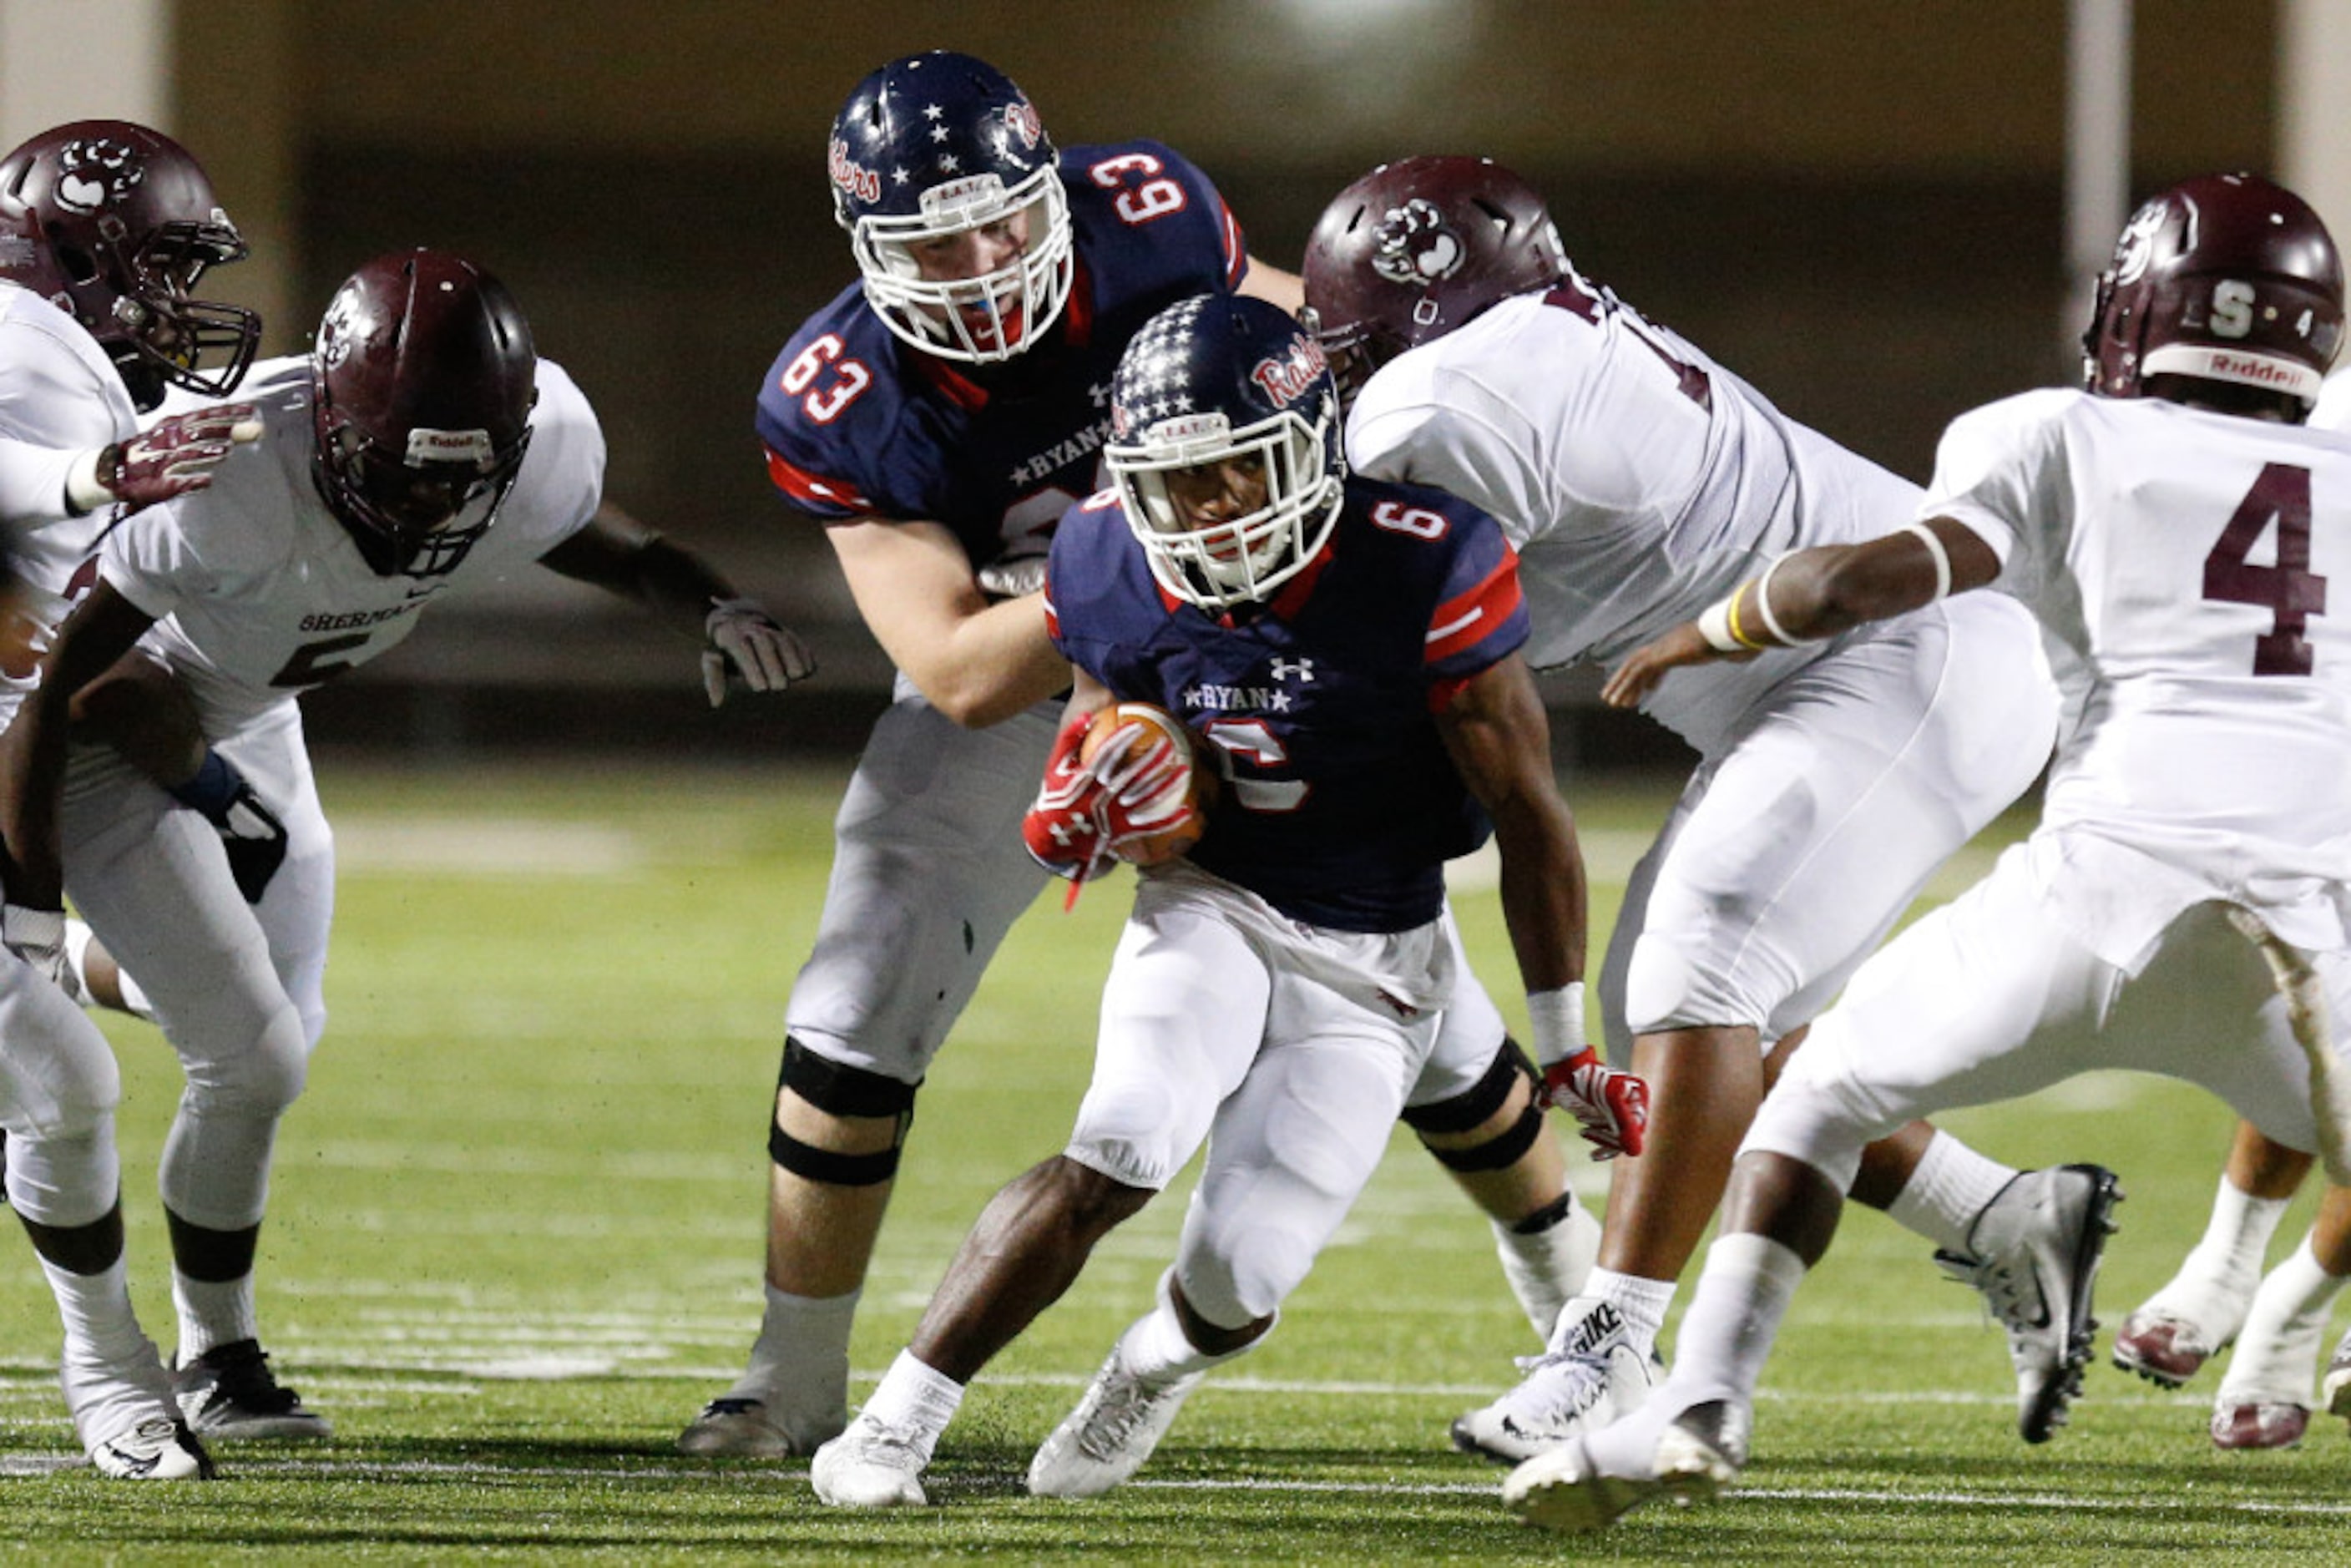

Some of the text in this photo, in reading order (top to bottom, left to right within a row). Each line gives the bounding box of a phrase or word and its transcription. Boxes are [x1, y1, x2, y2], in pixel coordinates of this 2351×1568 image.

[1086, 154, 1187, 226] 63
[2209, 279, 2255, 339] S
[2295, 308, 2313, 338] 4
[779, 331, 873, 427] 63
[1027, 423, 1101, 479] RYAN
[1368, 500, 1452, 543] 6
[2202, 461, 2328, 677] 4
[1201, 683, 1269, 711] RYAN
